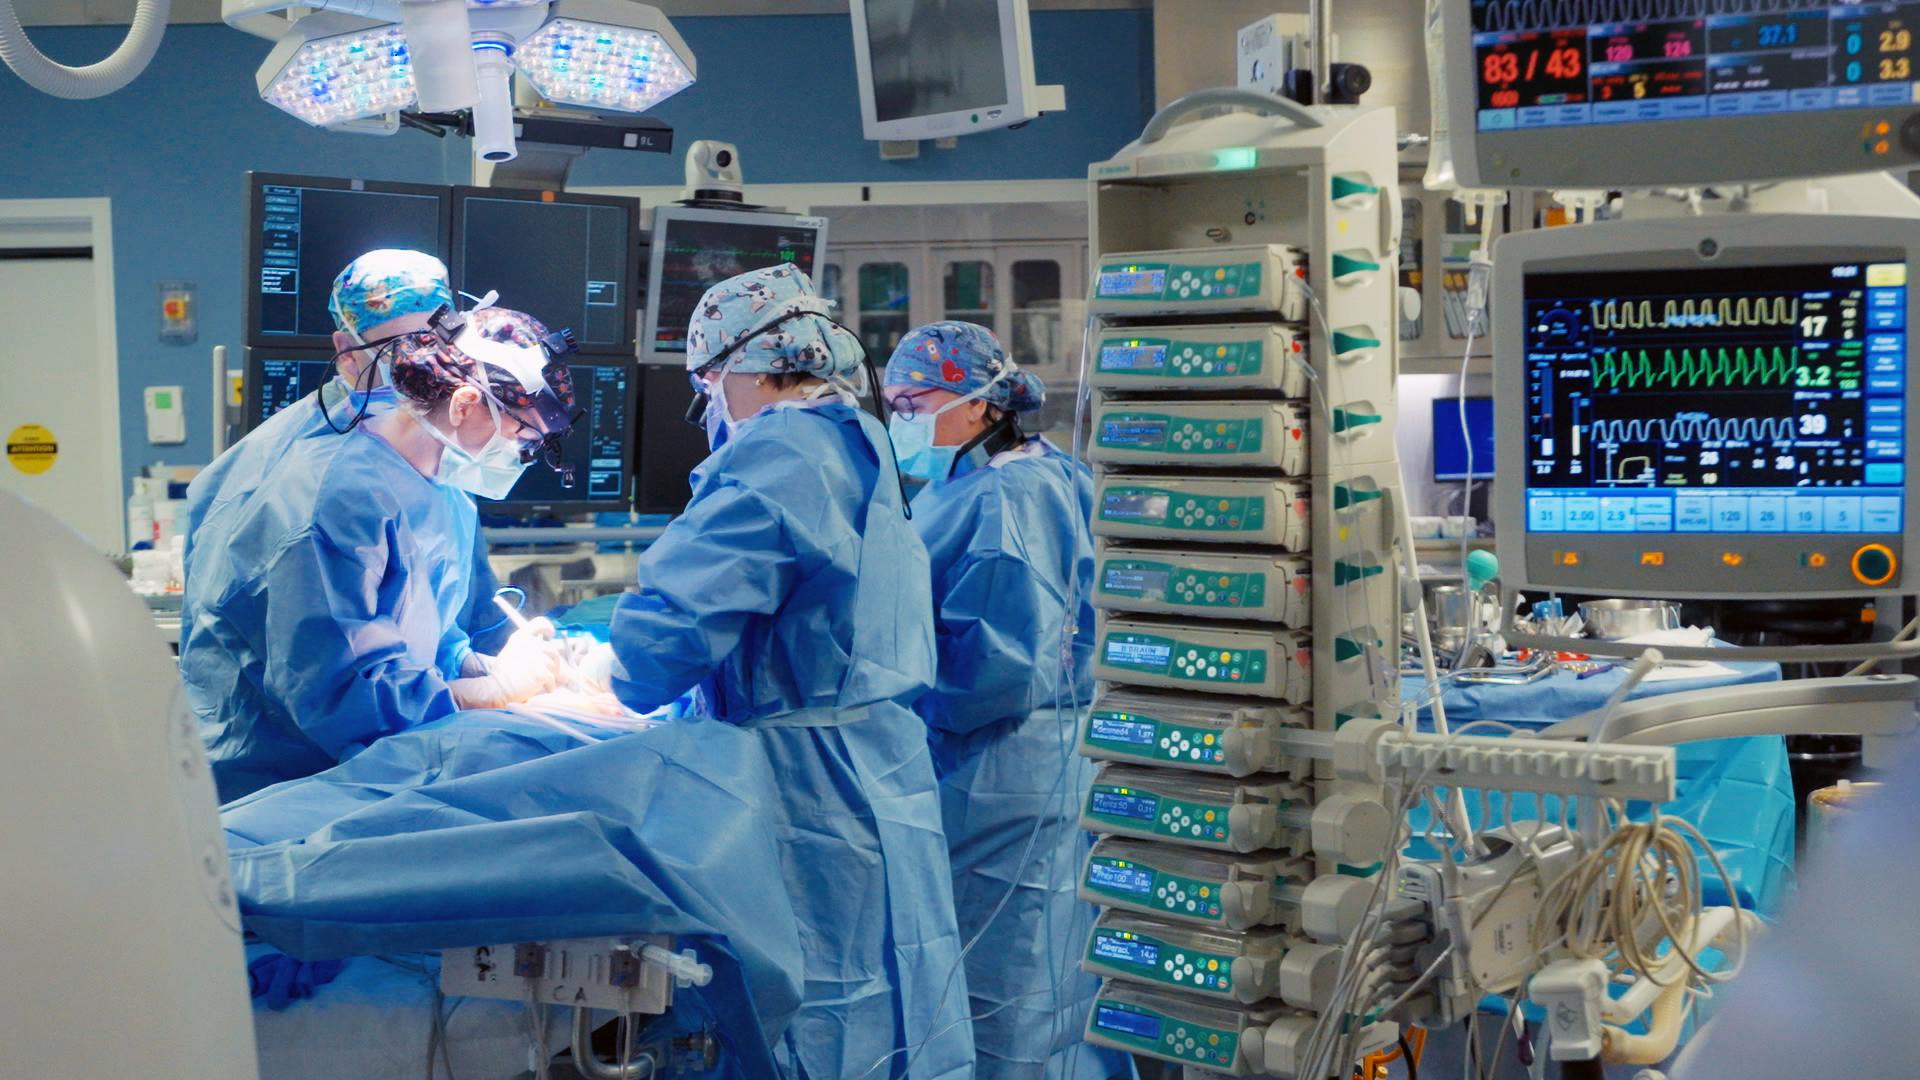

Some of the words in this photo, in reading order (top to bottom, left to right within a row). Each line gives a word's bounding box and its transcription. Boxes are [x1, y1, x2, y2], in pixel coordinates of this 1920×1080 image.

[1758, 23, 1798, 46] 37.1
[1879, 29, 1912, 53] 2.9
[1484, 53, 1519, 84] 83
[1545, 47, 1581, 79] 43
[1879, 57, 1911, 80] 3.3
[1800, 315, 1828, 337] 17
[1796, 365, 1831, 387] 3.2
